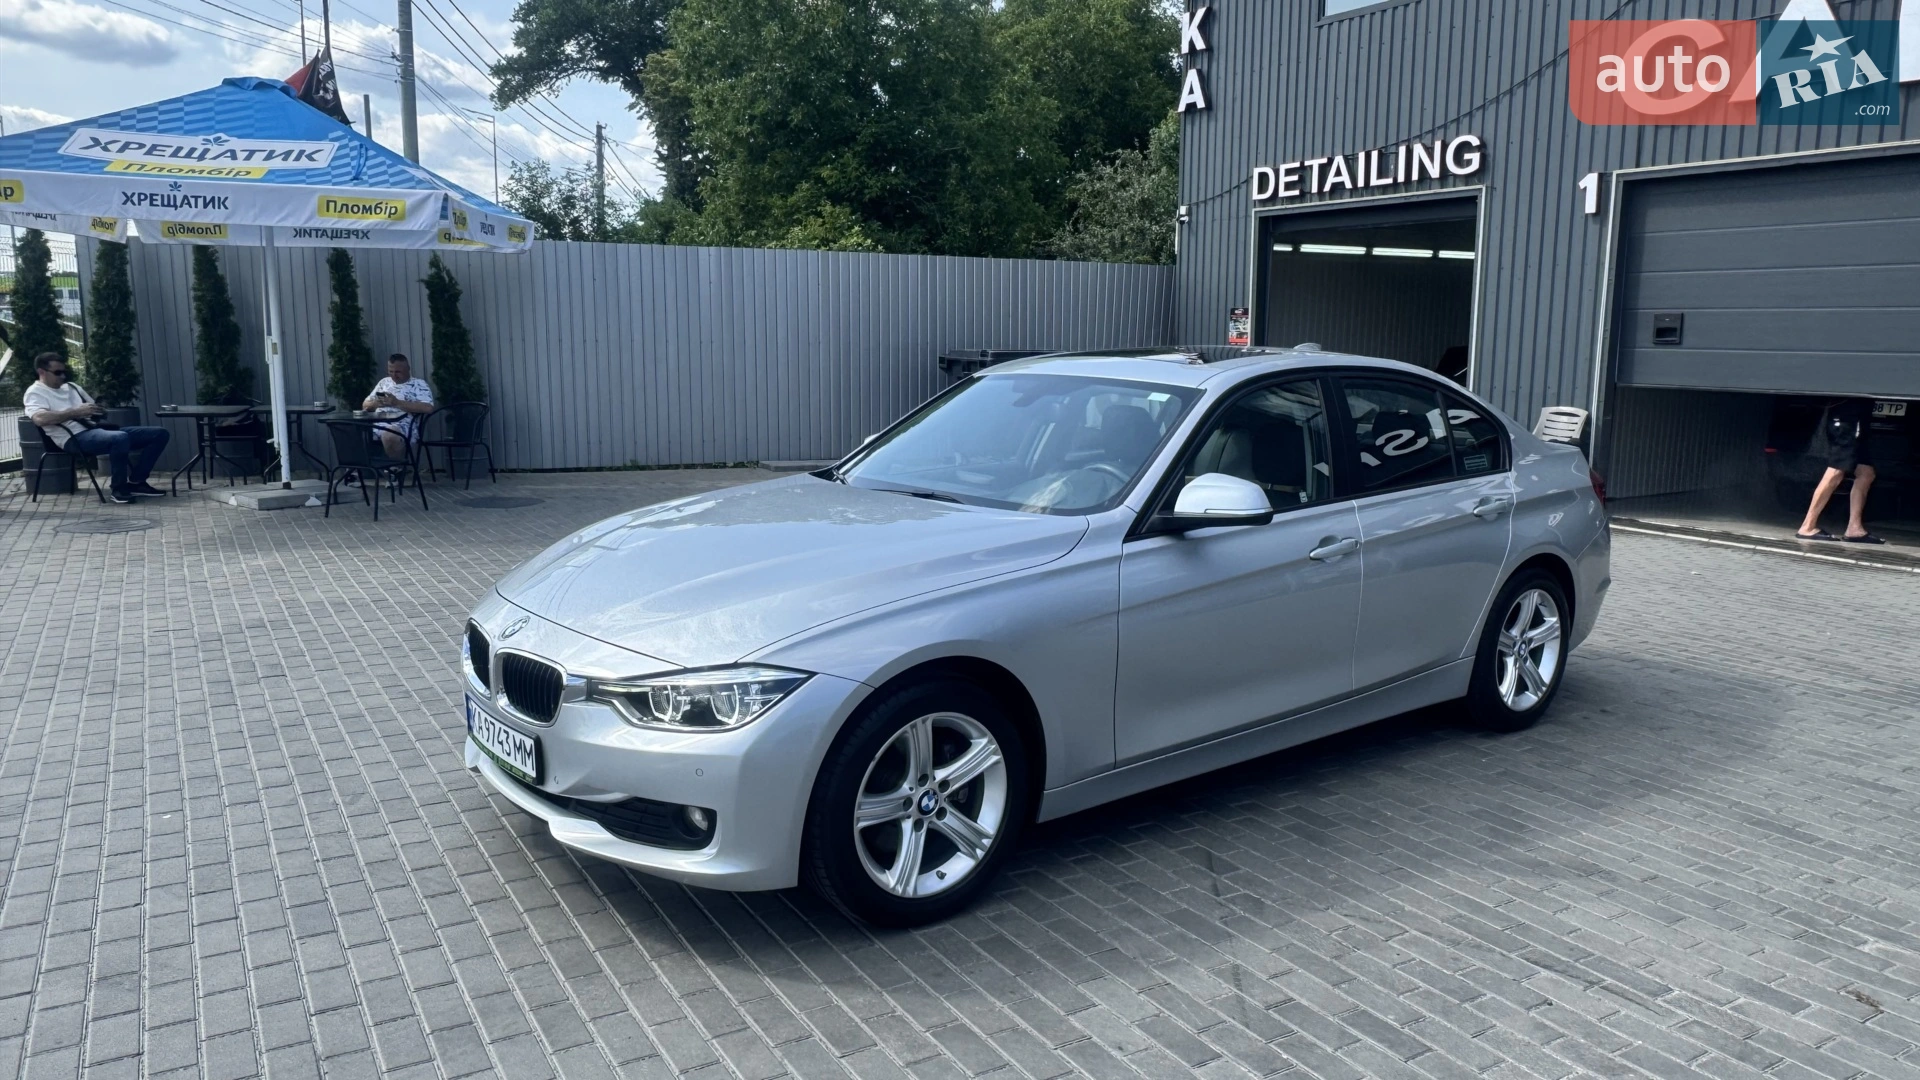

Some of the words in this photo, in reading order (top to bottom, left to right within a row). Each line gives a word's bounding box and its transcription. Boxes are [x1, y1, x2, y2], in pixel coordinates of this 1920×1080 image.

[79, 136, 326, 163] ХРЕЩАТИК
[122, 163, 253, 178] Пломбір
[1252, 134, 1481, 200] DETAILING
[121, 191, 229, 211] ХРЕЩАТИК
[1578, 172, 1599, 214] 1
[325, 199, 398, 219] Пломбір
